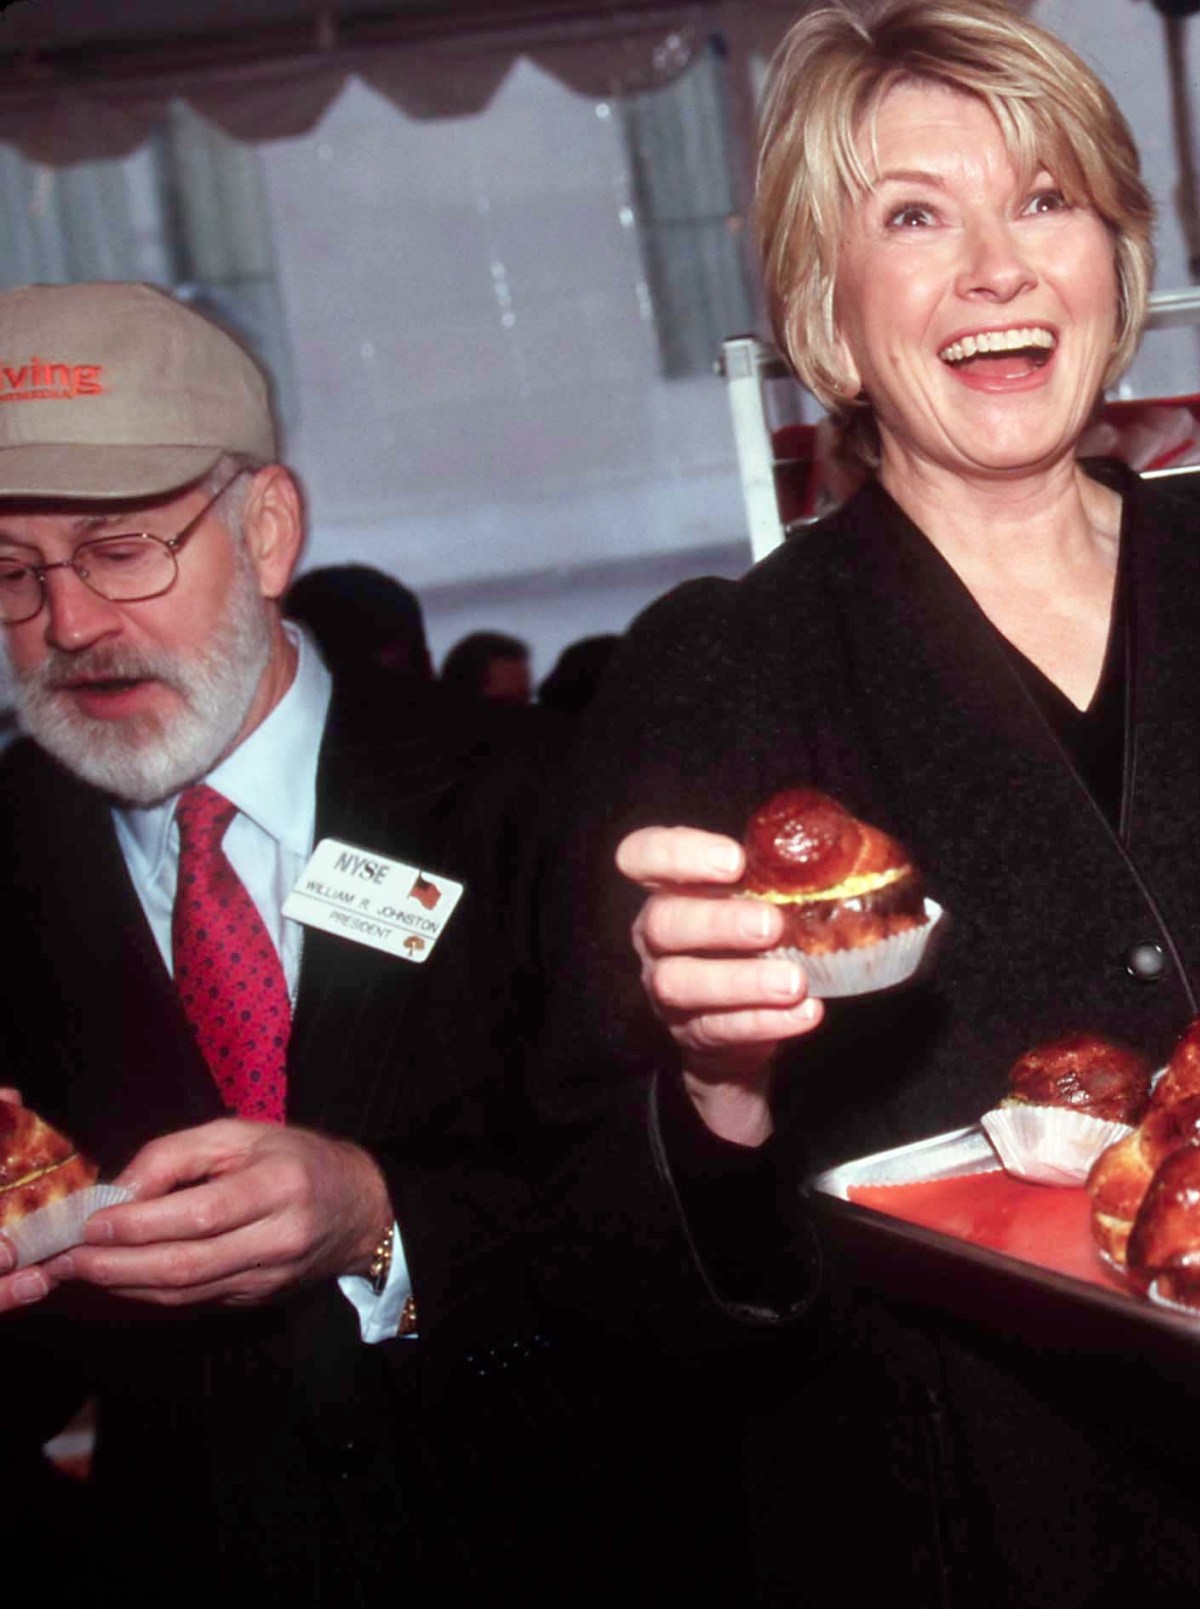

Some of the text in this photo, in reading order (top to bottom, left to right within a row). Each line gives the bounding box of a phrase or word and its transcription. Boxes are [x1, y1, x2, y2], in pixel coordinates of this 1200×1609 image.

[335, 852, 389, 885] NYSE
[306, 881, 355, 904] WILLIAM
[377, 905, 439, 934] JOHNSTON
[328, 911, 393, 940] PRESIDENT
